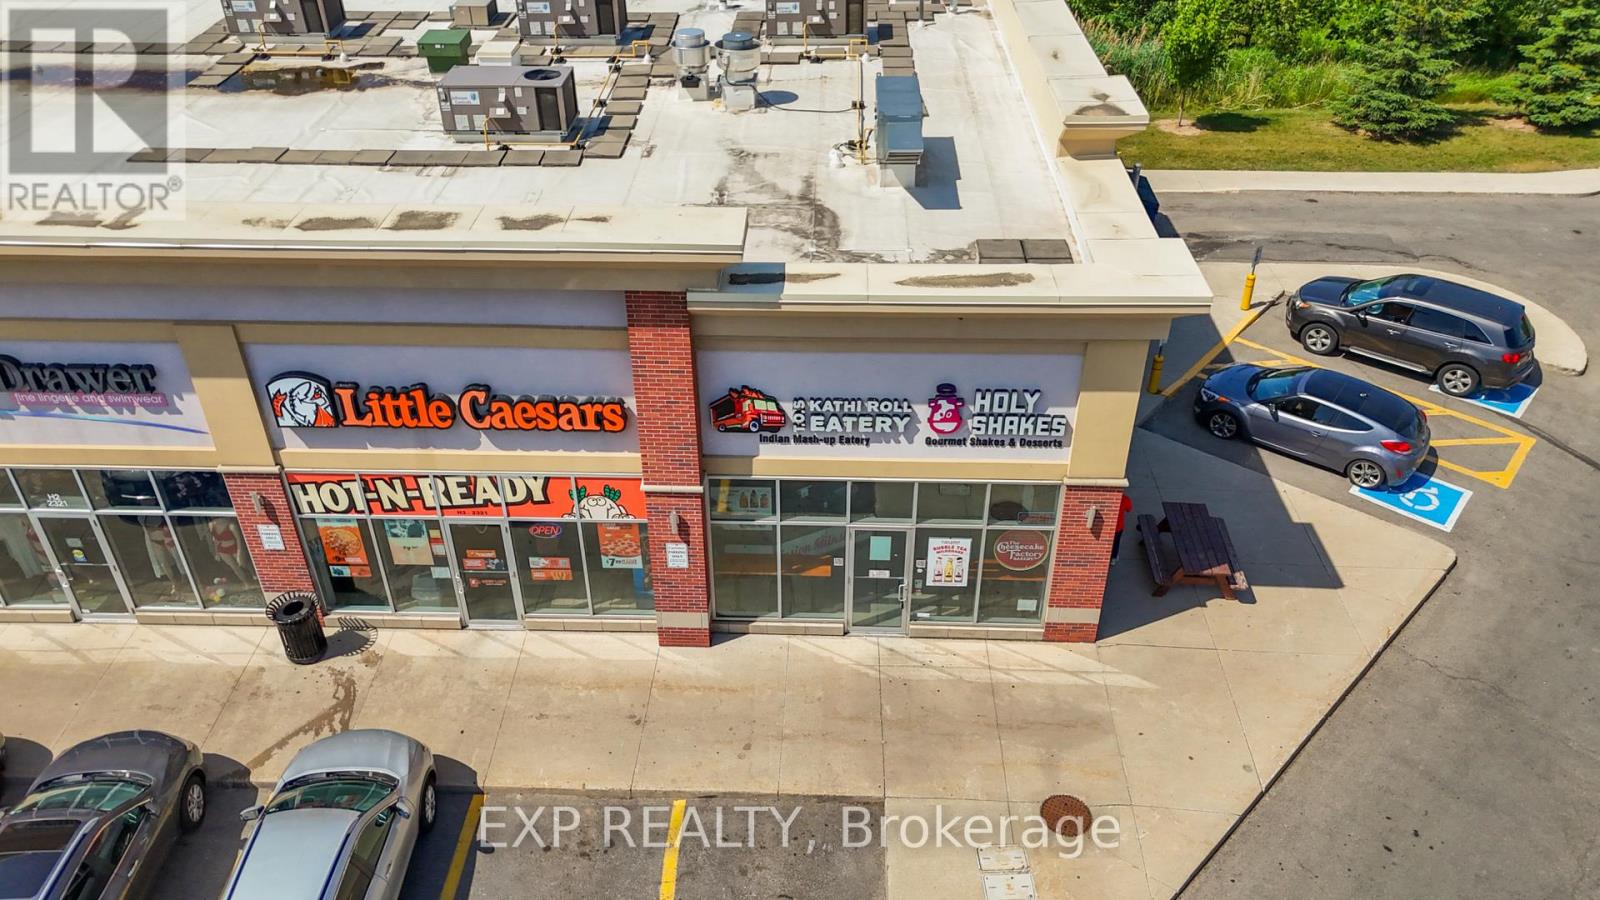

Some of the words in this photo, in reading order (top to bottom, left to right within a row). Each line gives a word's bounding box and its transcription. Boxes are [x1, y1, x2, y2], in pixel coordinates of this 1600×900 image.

[14, 393, 36, 405] fine
[38, 393, 79, 404] lingerie
[82, 394, 105, 404] and
[107, 395, 163, 404] swimwear
[809, 398, 861, 412] KATHI
[866, 399, 913, 413] ROLL
[974, 389, 1042, 414] HOLY
[334, 381, 456, 430] Little
[459, 383, 627, 432] Caesars
[809, 414, 912, 433] EATERY
[971, 414, 1067, 437] SHAKES
[759, 434, 790, 444] Indian
[793, 435, 836, 447] Mash-up
[838, 435, 871, 447] Eatery
[925, 437, 968, 447] Gourmet
[969, 438, 1006, 448] Shakes
[1008, 439, 1016, 448] &
[1019, 439, 1063, 449] Desserts
[531, 525, 560, 535] OPEN
[996, 541, 1044, 554] Cheesecake
[1006, 549, 1044, 560] Factory
